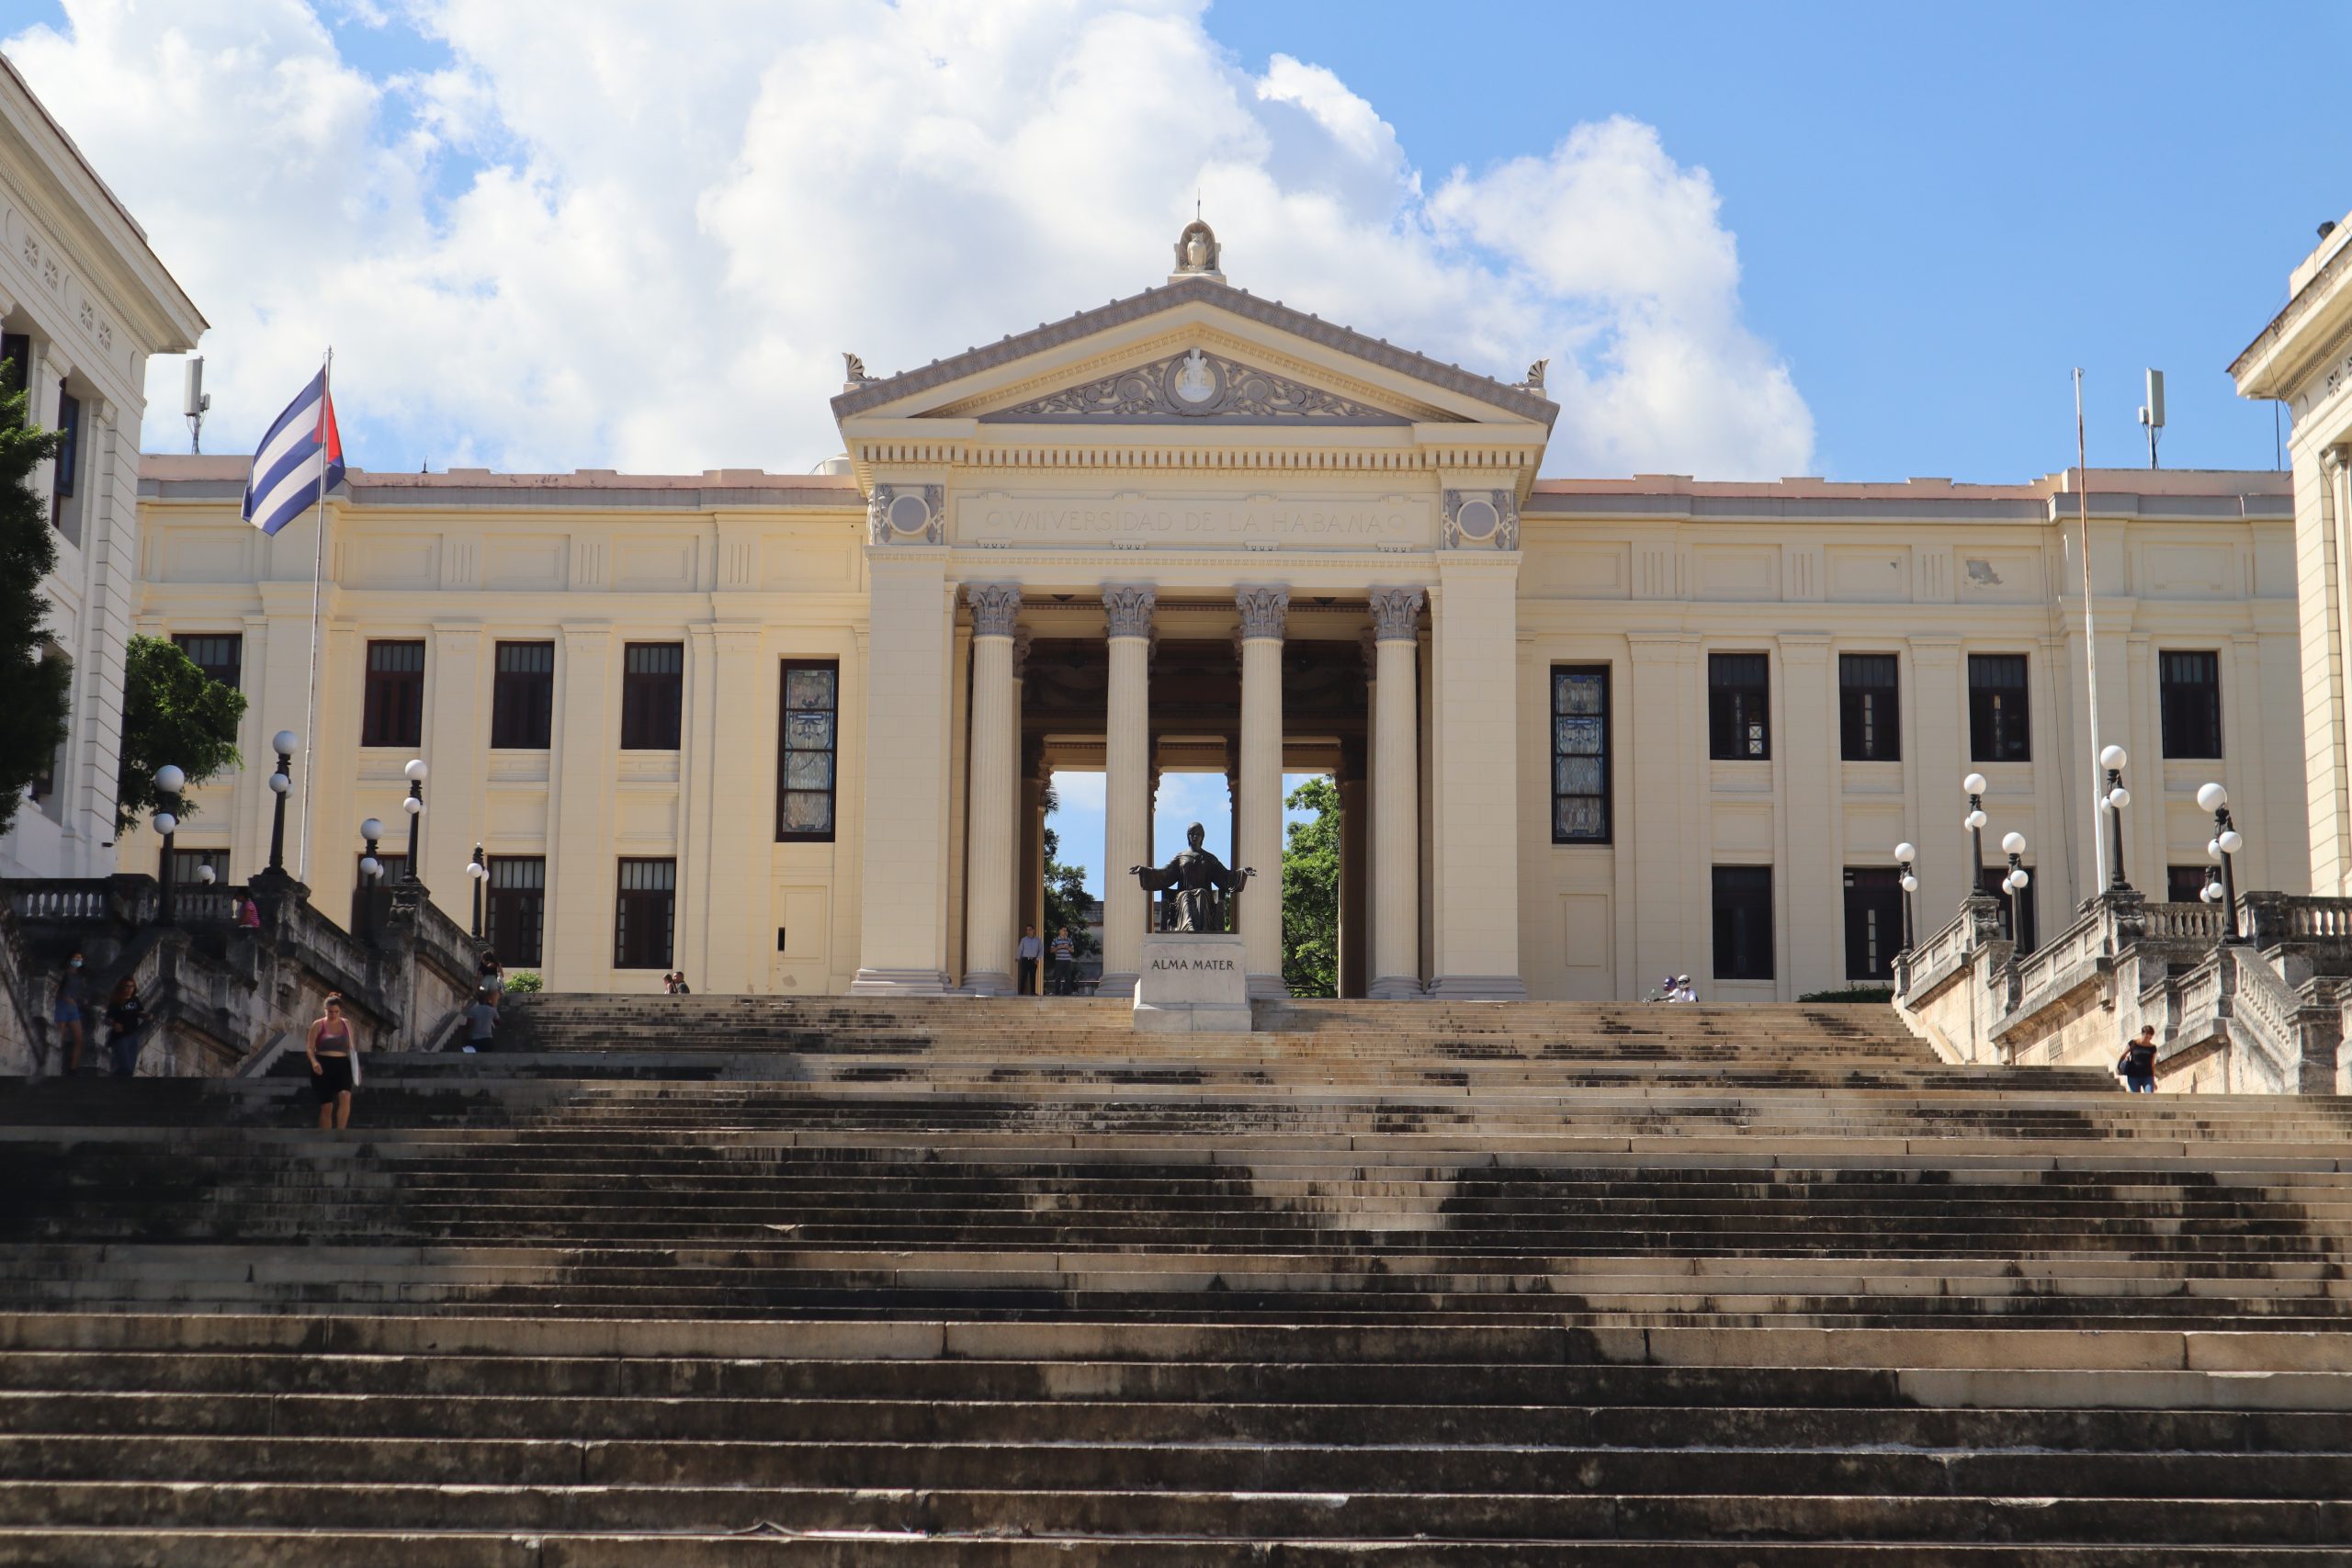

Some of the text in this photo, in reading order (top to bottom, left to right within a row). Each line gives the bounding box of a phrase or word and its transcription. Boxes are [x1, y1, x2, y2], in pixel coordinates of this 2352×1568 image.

[1184, 512, 1215, 532] DE
[1227, 512, 1261, 532] LA
[1272, 512, 1383, 533] HABANA
[1151, 959, 1236, 971] ALMA MATER
